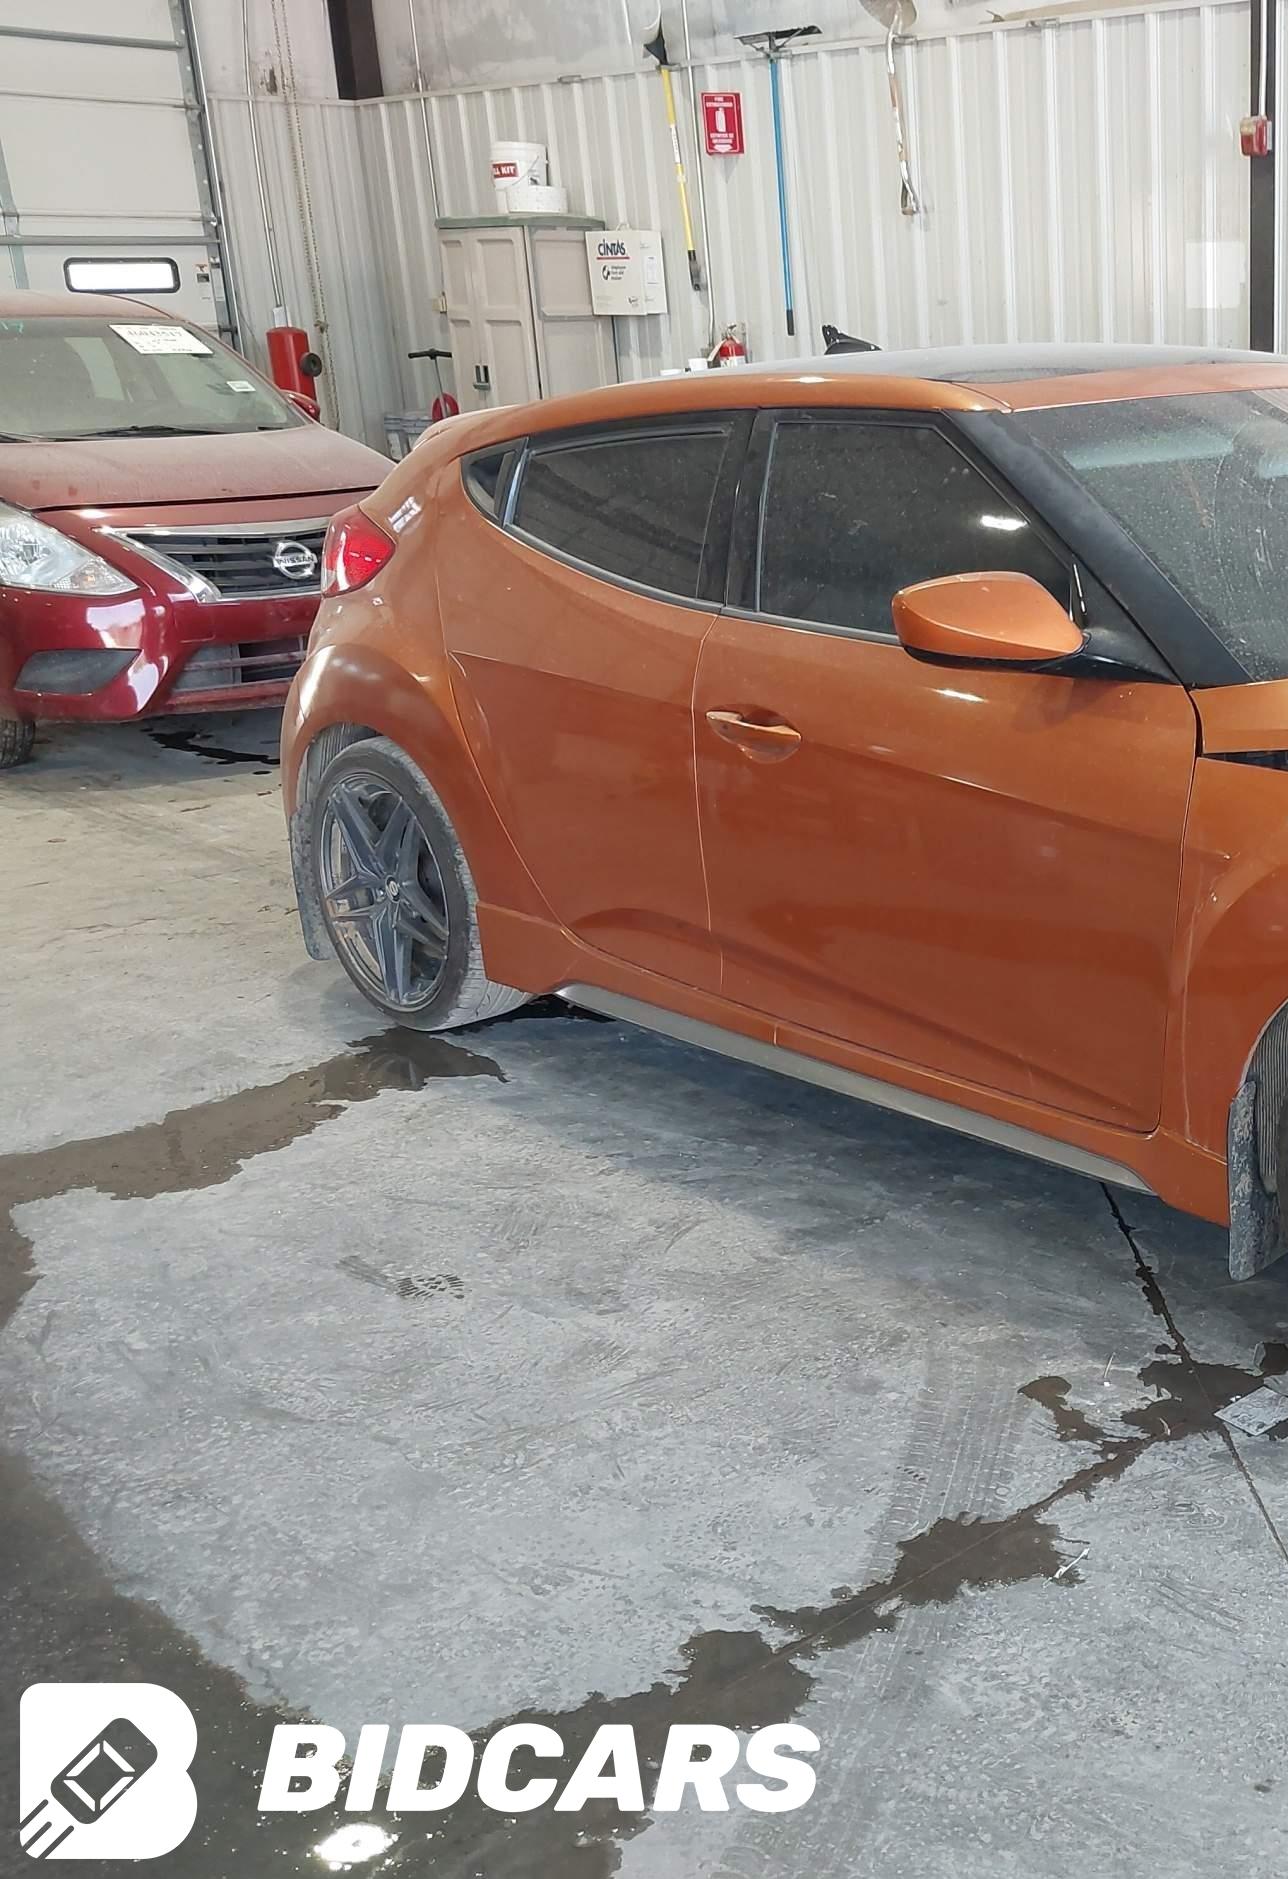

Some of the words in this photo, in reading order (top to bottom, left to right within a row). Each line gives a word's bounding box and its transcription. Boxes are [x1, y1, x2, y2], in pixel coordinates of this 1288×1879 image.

[501, 165, 515, 175] KIT
[598, 239, 626, 256] CINTAS
[277, 553, 315, 565] NISSAN
